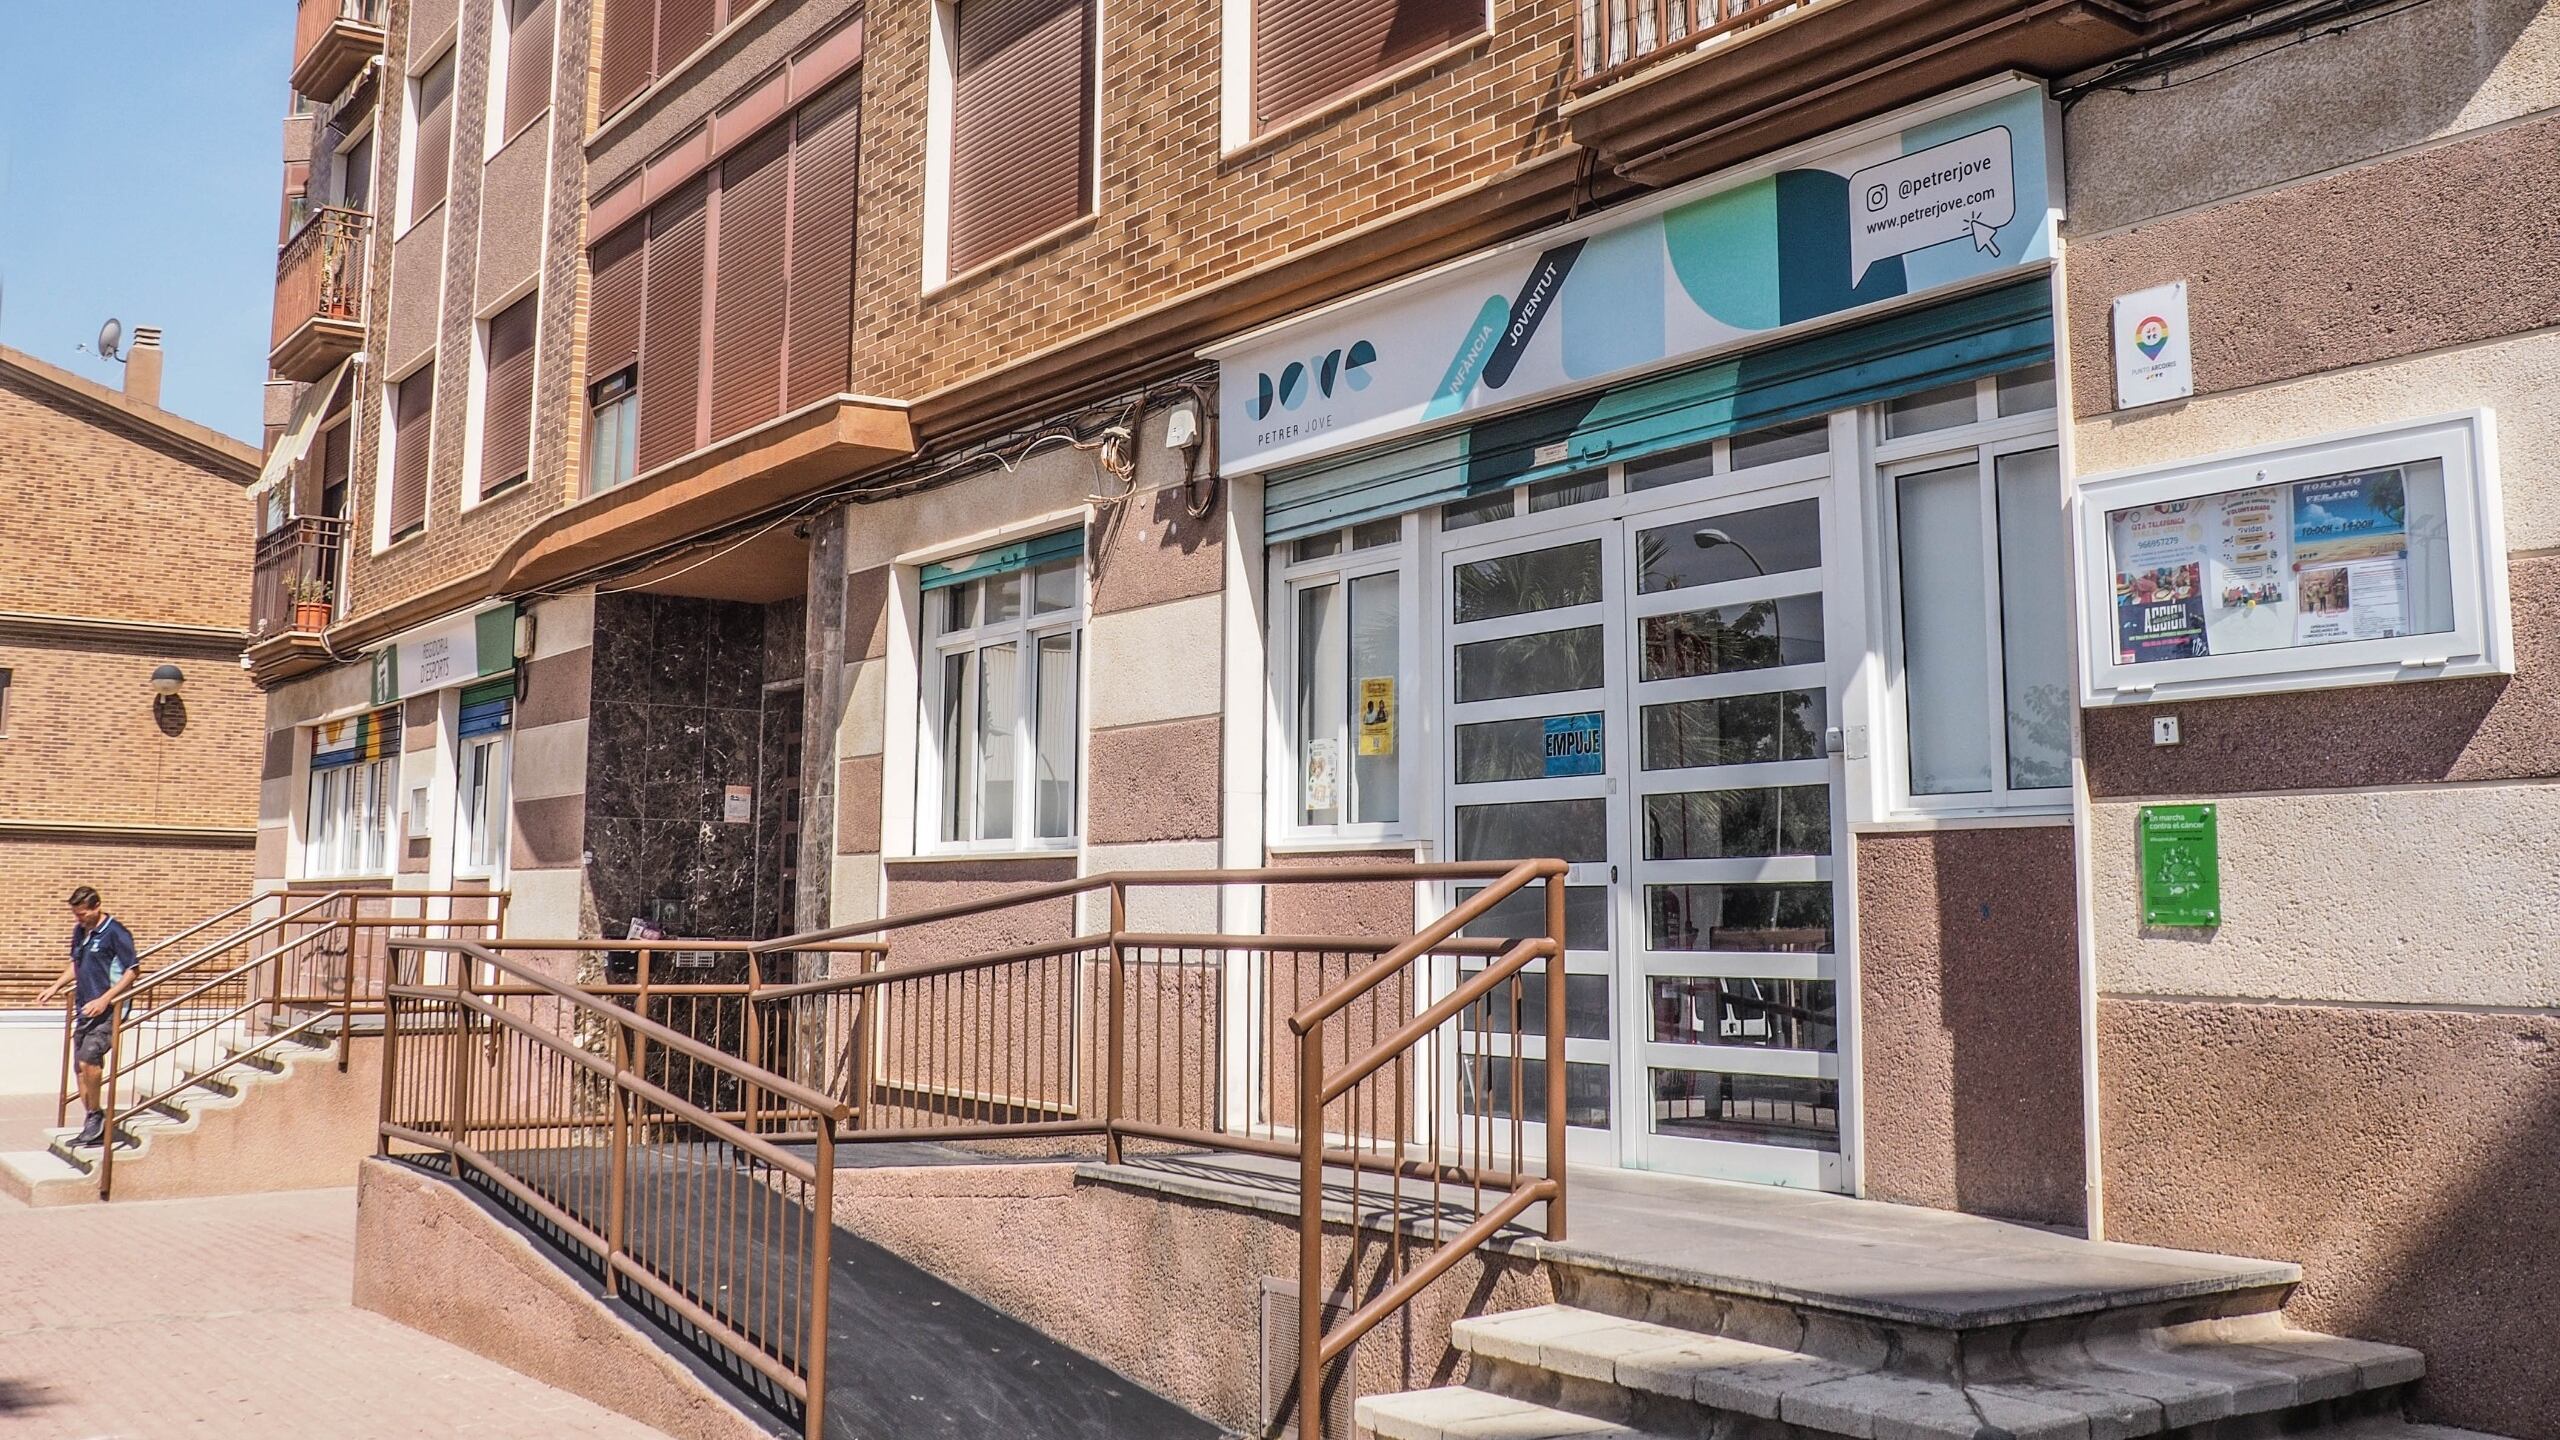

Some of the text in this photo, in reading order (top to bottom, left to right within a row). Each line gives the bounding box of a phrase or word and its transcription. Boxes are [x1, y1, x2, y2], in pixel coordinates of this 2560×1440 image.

[1898, 157, 1992, 200] @petrerjove
[1866, 187, 1996, 235] www.petrerjove.com
[1509, 261, 1558, 347] JOVENTUT
[1449, 325, 1494, 396] INFÀNCIA
[1258, 414, 1334, 446] PETRER JOVE
[1544, 729, 1601, 757] EMPUJE
[2149, 822, 2172, 830] contra
